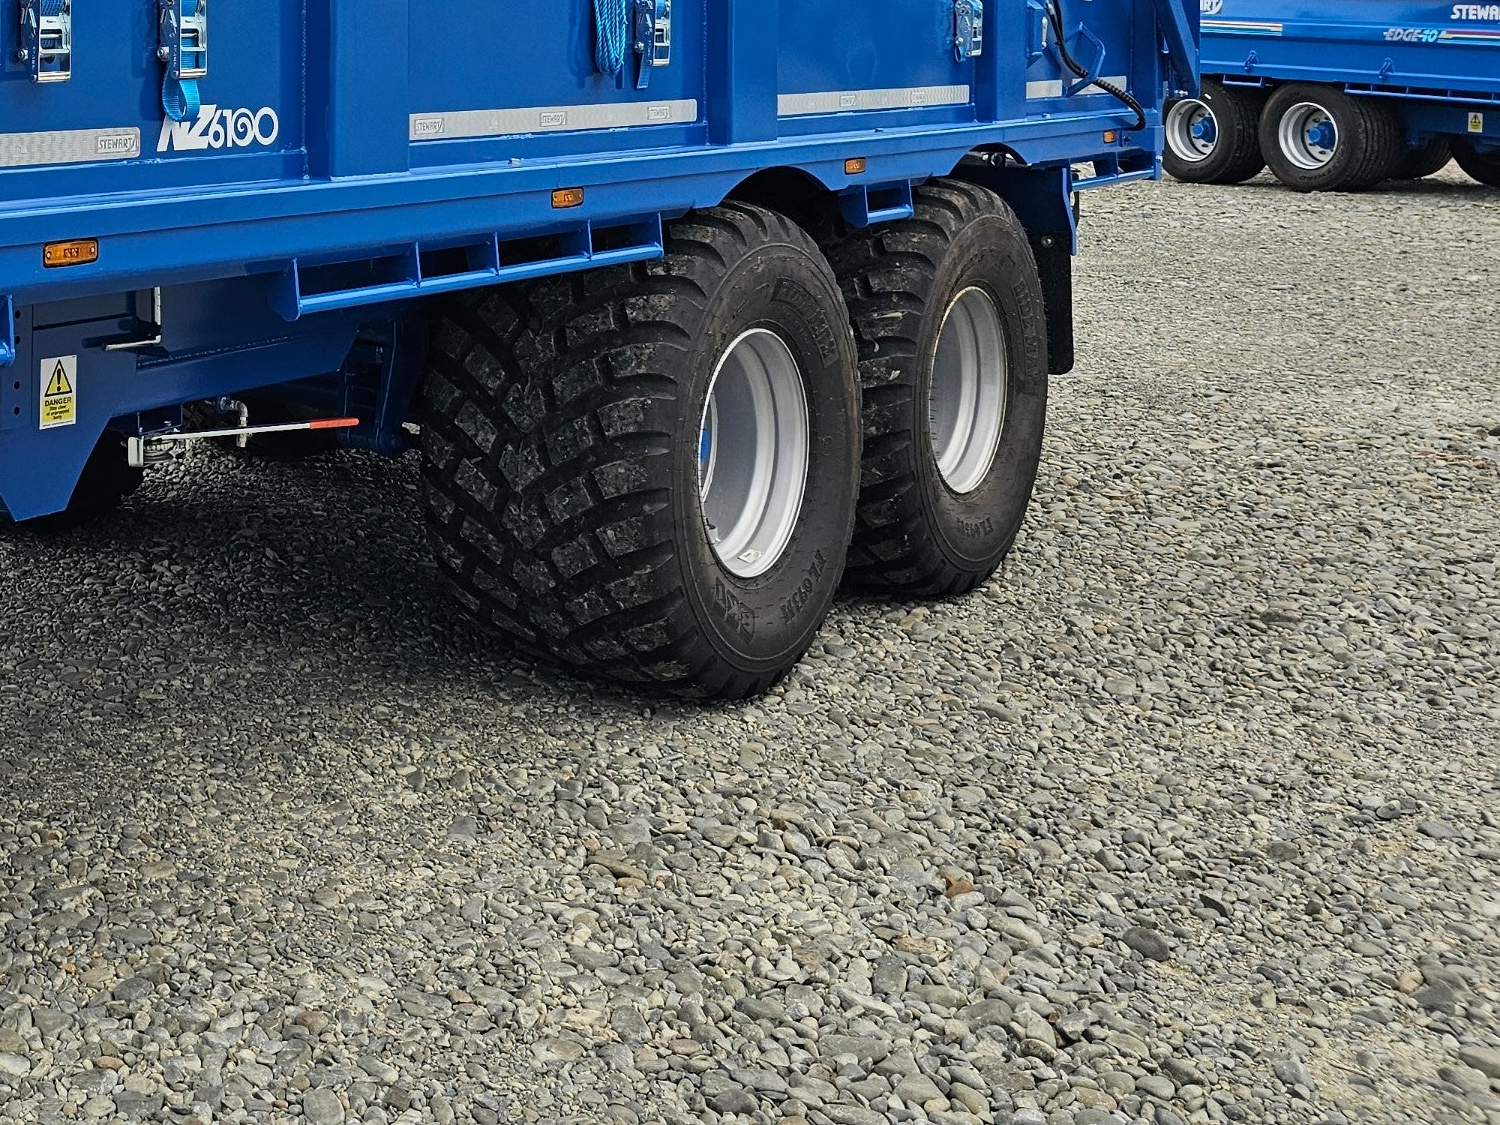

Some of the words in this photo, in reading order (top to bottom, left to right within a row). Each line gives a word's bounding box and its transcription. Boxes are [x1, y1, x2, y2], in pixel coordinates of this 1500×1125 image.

[1450, 4, 1500, 21] STEWA
[156, 104, 279, 152] NZ6100
[414, 118, 443, 133] STEWART
[98, 134, 136, 152] STEWART
[44, 396, 72, 407] DANGER
